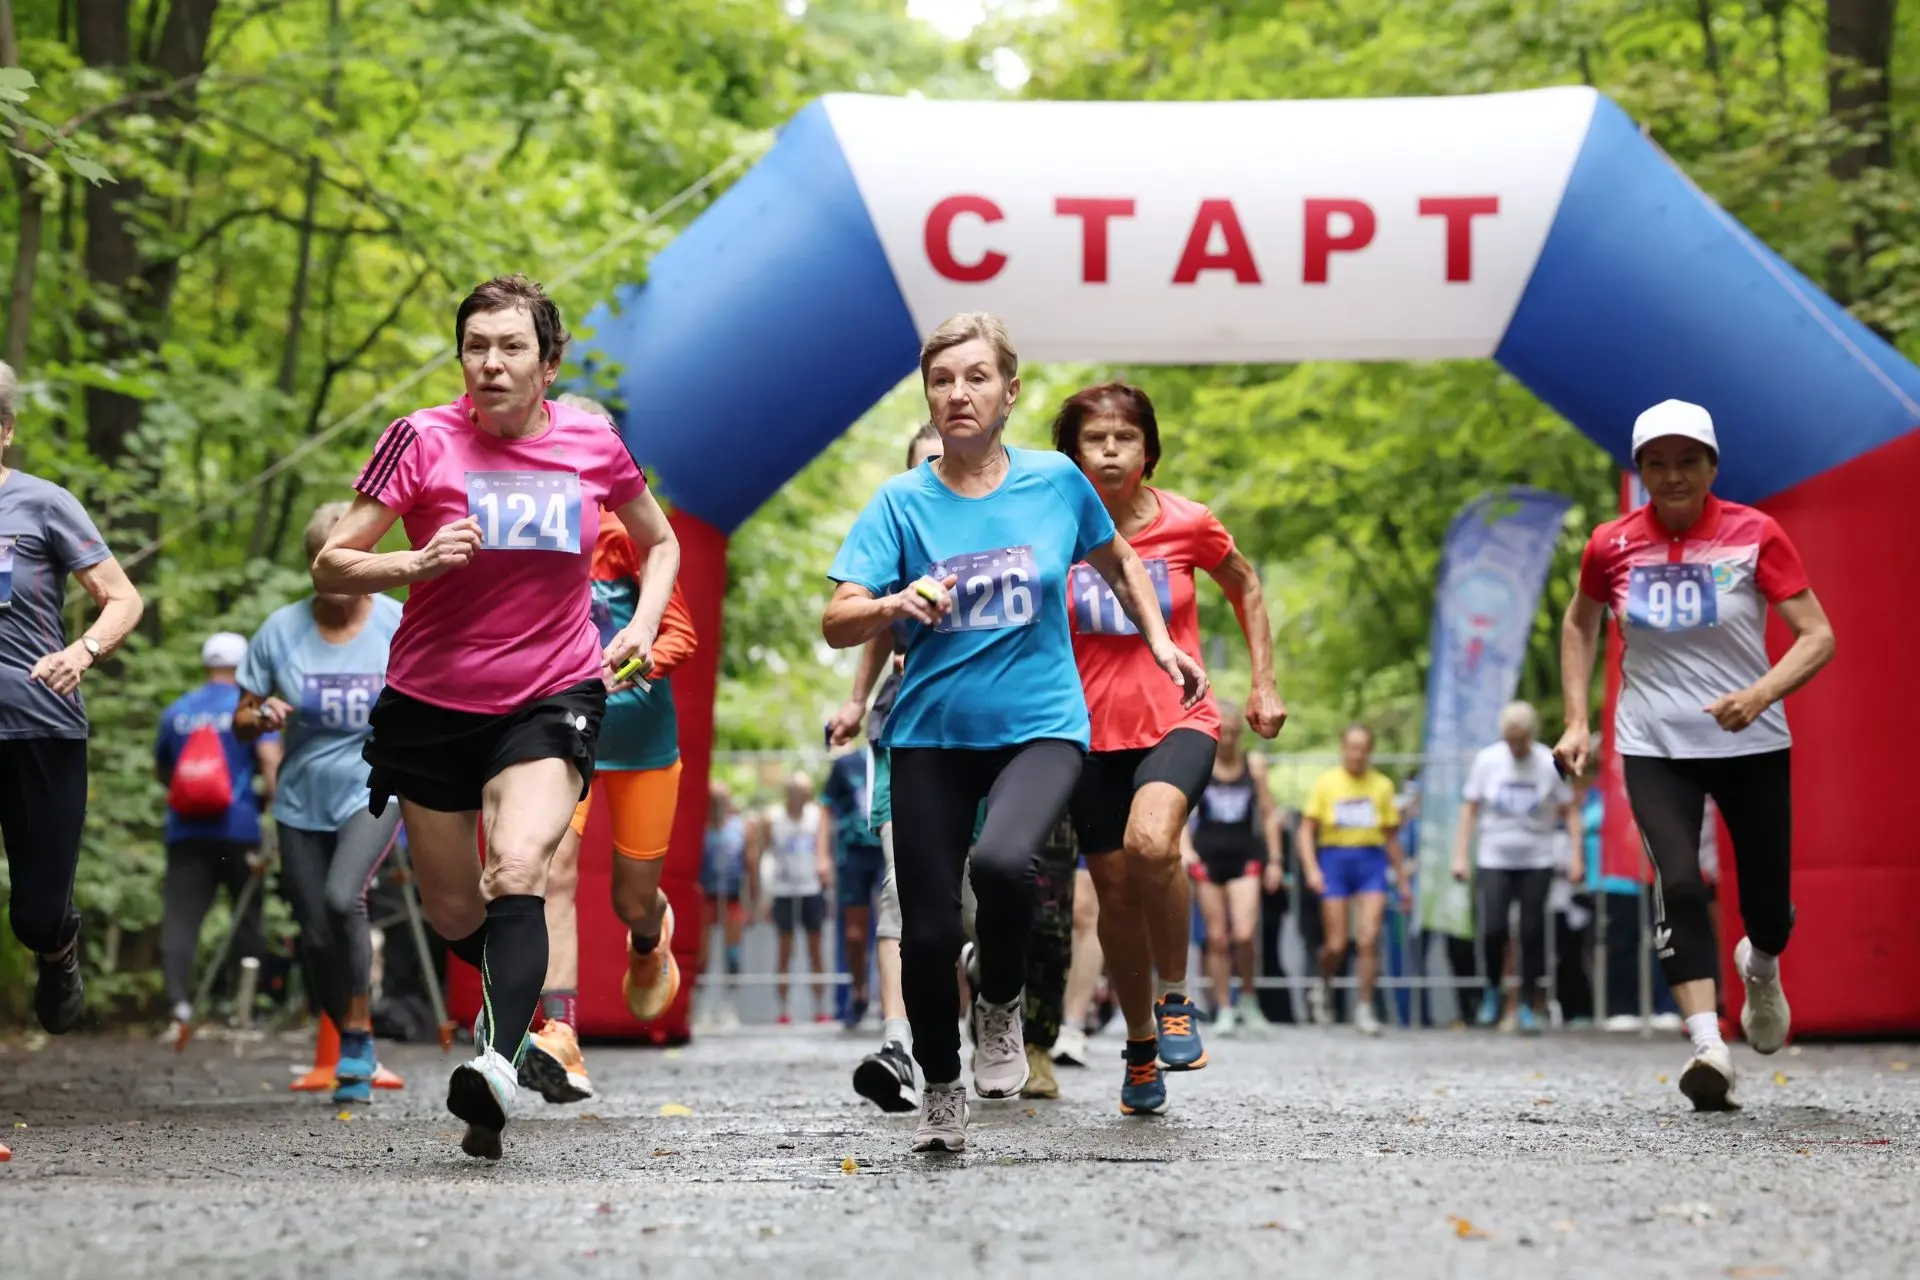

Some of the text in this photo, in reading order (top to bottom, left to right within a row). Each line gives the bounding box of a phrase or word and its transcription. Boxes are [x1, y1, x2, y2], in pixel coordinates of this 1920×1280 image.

[923, 194, 1499, 284] СТАРТ
[479, 493, 569, 548] 124
[947, 568, 1033, 627] 126
[1082, 585, 1125, 631] 11
[1647, 580, 1702, 628] 99
[321, 687, 370, 729] 56
